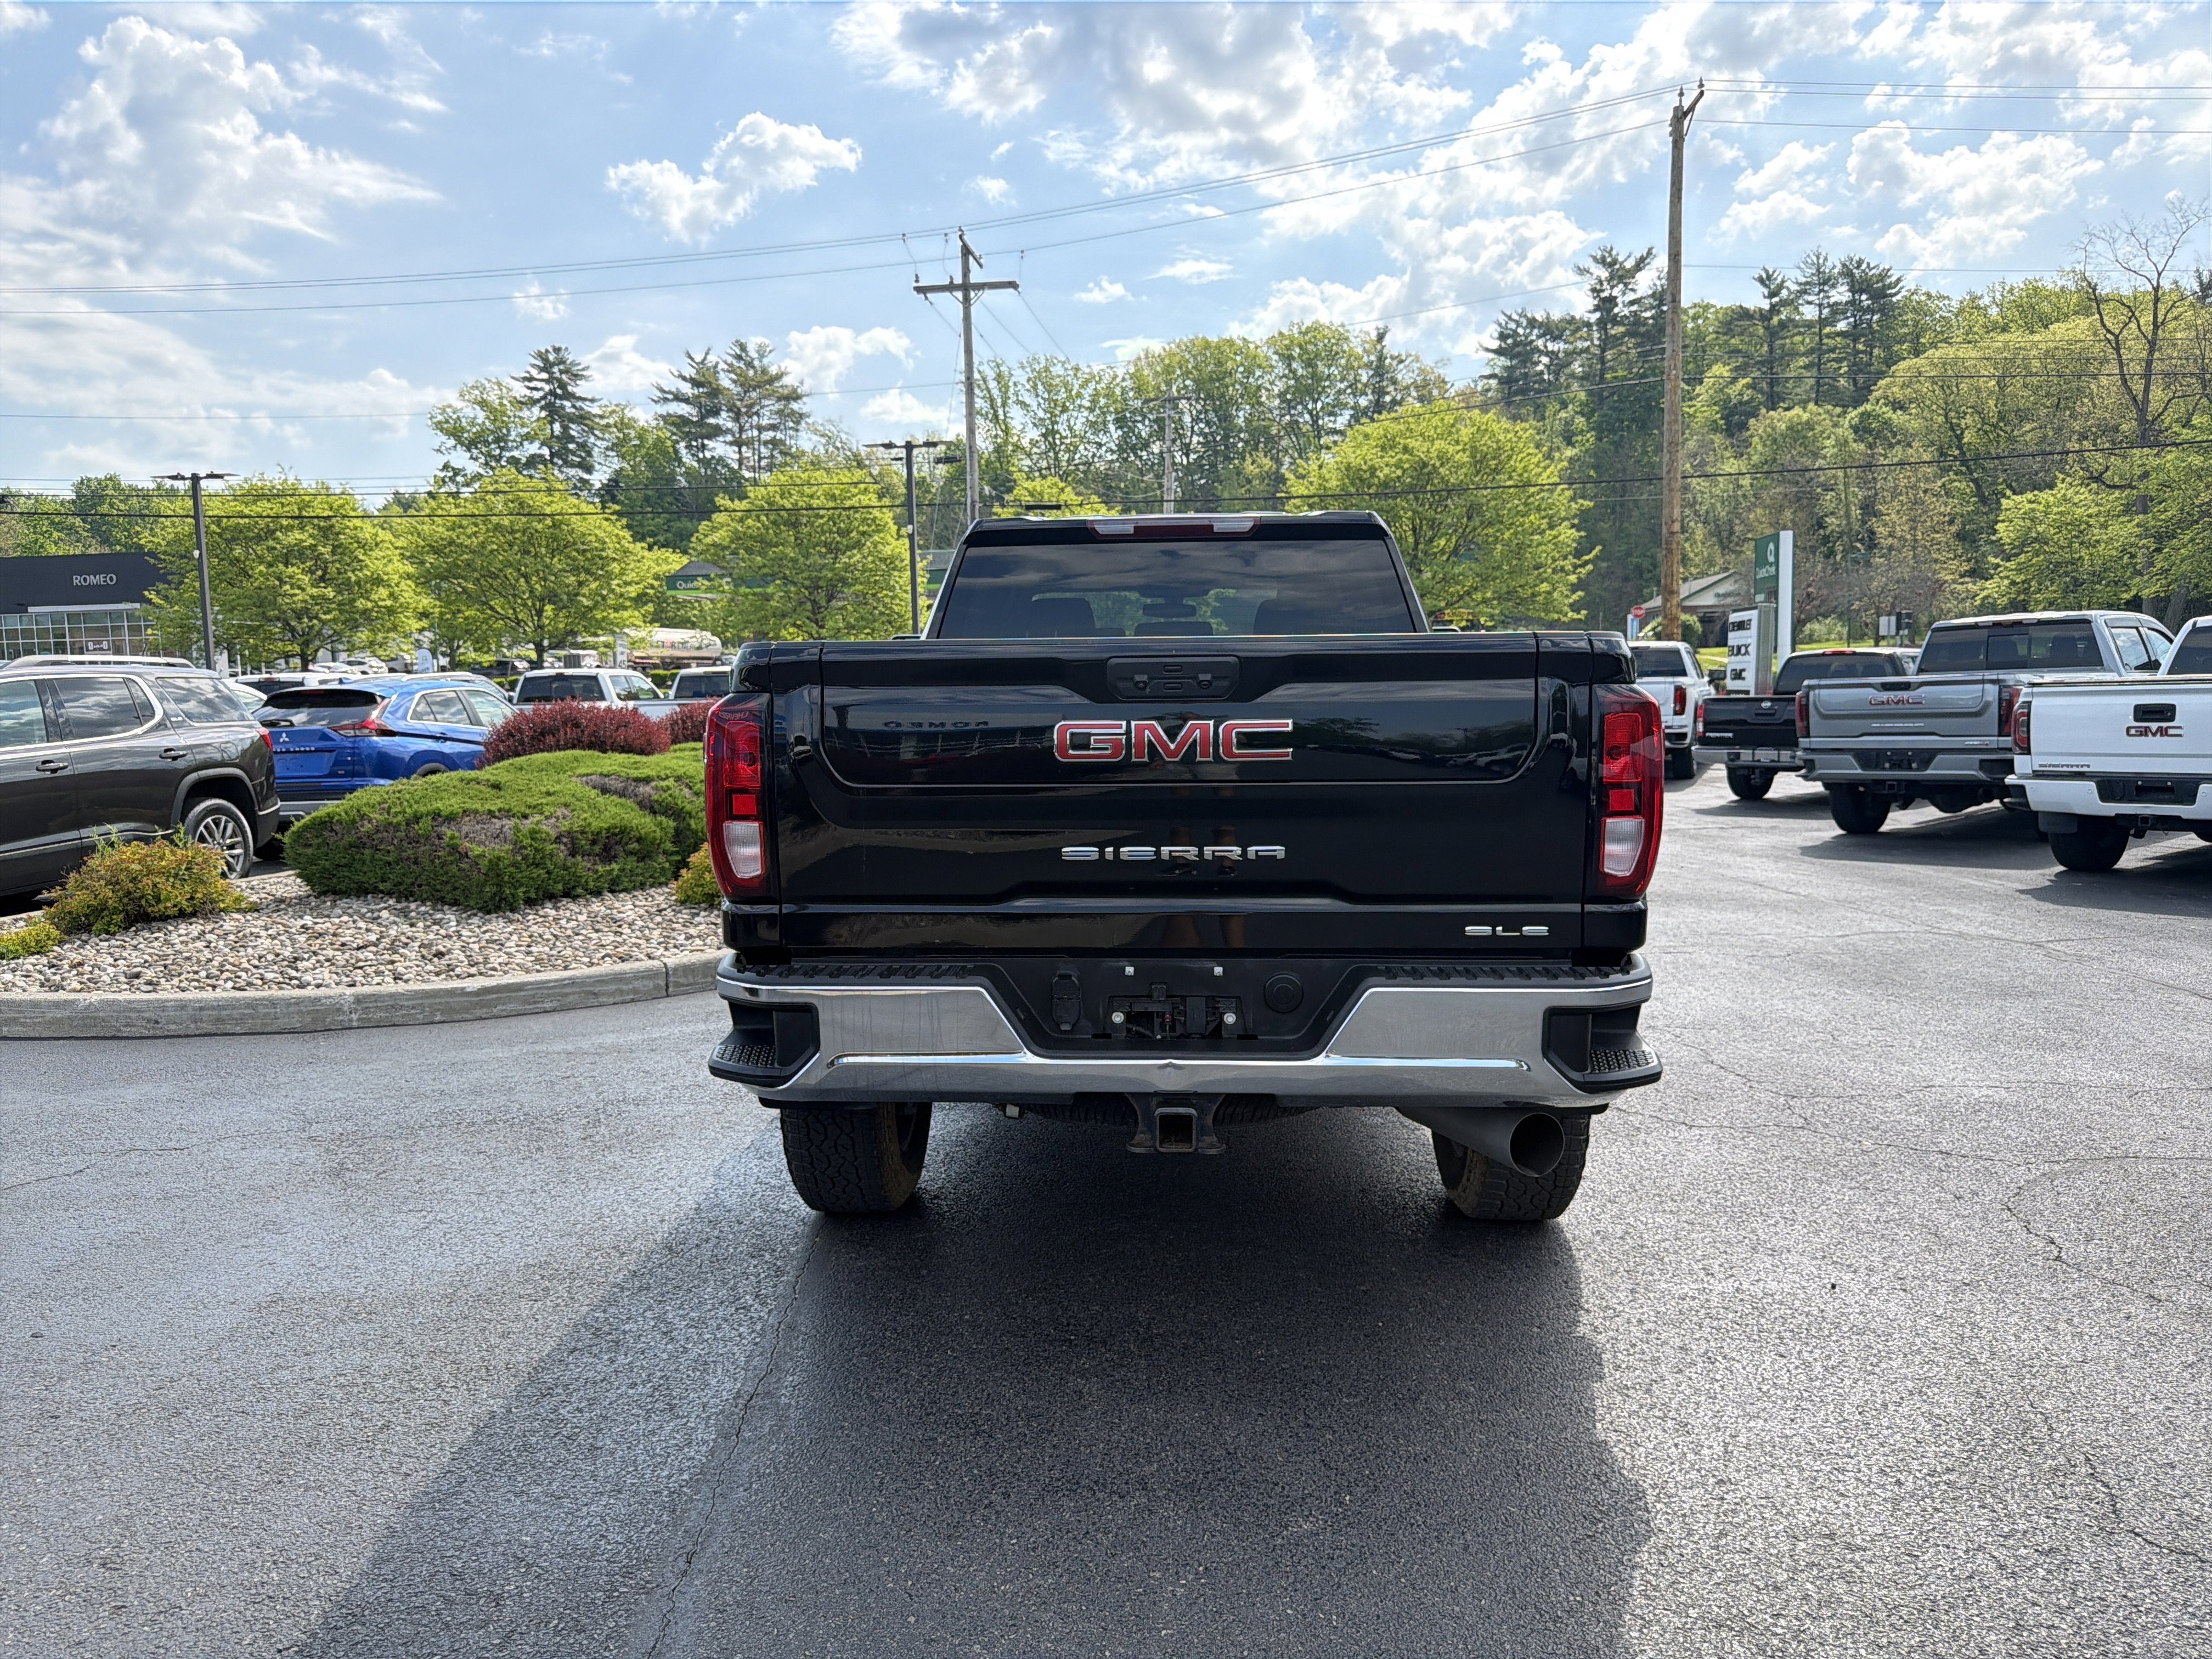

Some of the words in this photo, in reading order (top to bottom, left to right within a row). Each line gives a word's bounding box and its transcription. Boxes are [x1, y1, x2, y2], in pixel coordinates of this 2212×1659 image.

[72, 573, 117, 586] ROMEO
[1728, 643, 1751, 657] BUICK
[618, 660, 626, 669] 45
[1869, 694, 1926, 706] GMC
[2126, 726, 2183, 737] GMC
[1053, 719, 1294, 763] GMC
[1061, 846, 1286, 861] SIERRA
[1465, 926, 1549, 936] SLE
